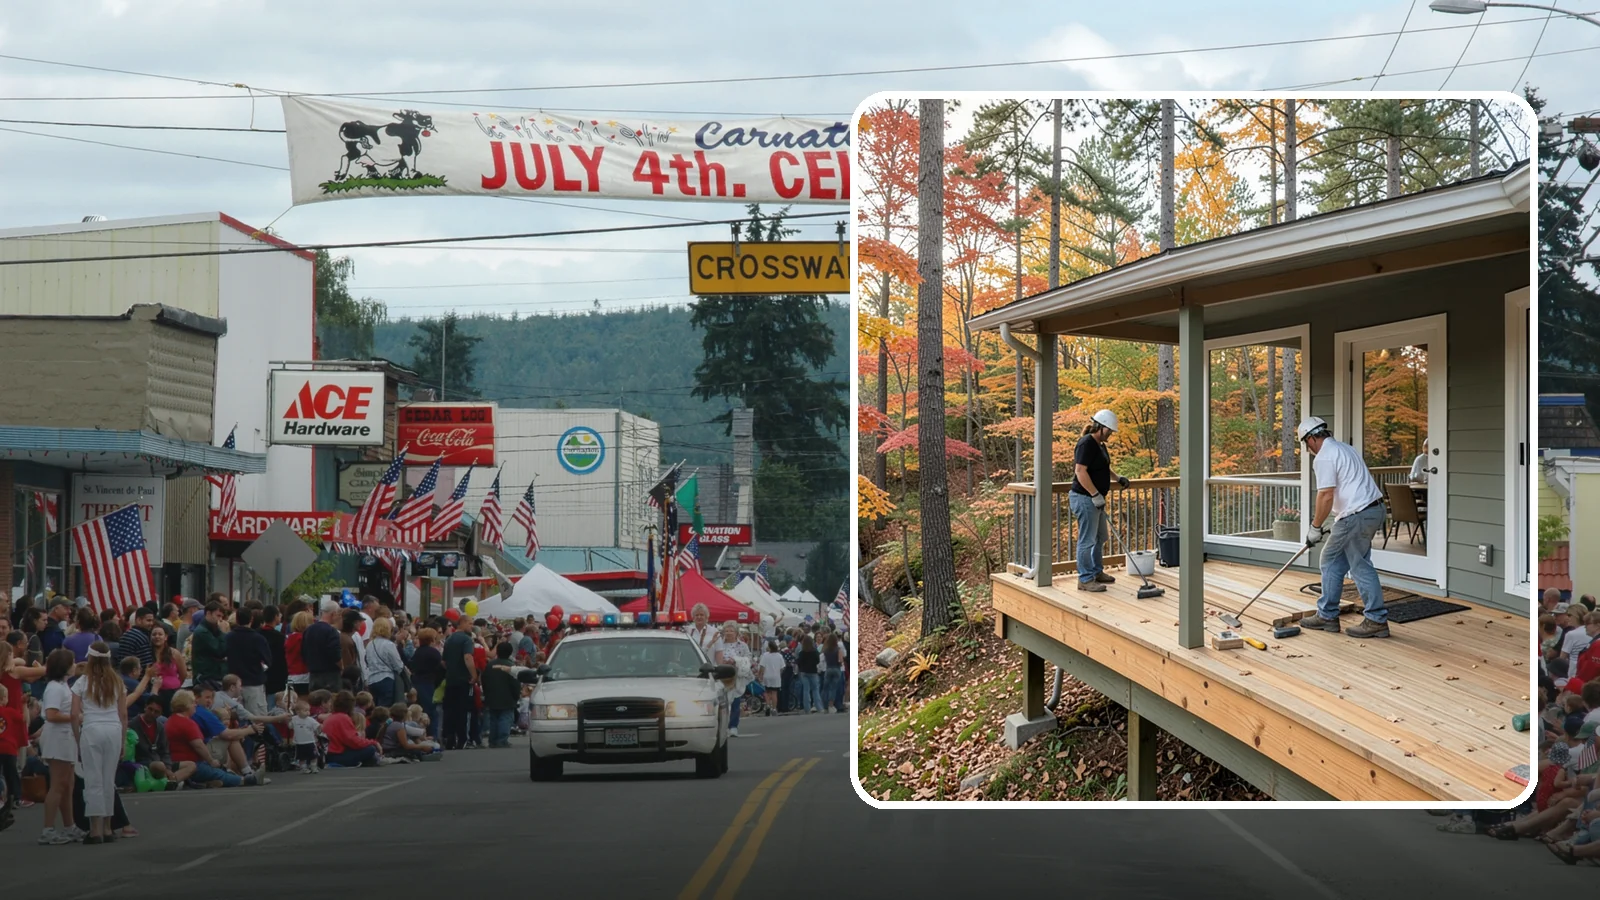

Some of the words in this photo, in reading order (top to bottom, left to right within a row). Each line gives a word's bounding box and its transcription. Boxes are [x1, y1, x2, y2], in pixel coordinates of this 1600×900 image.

[481, 141, 604, 193] JULY
[632, 150, 746, 197] 4th.
[697, 254, 850, 280] CROSSWA
[283, 380, 373, 420] ACE
[405, 409, 452, 422] CEDAR
[461, 409, 484, 422] LOG
[284, 421, 370, 436] Hardware
[353, 467, 386, 479] Simpl
[83, 485, 93, 494] St.
[96, 485, 124, 494] Vincent
[126, 486, 135, 494] de
[137, 486, 155, 495] Paul
[81, 503, 153, 522] THT
[212, 516, 331, 535] HARDARE
[688, 526, 741, 535] CRNATION
[699, 535, 730, 543] GLASS
